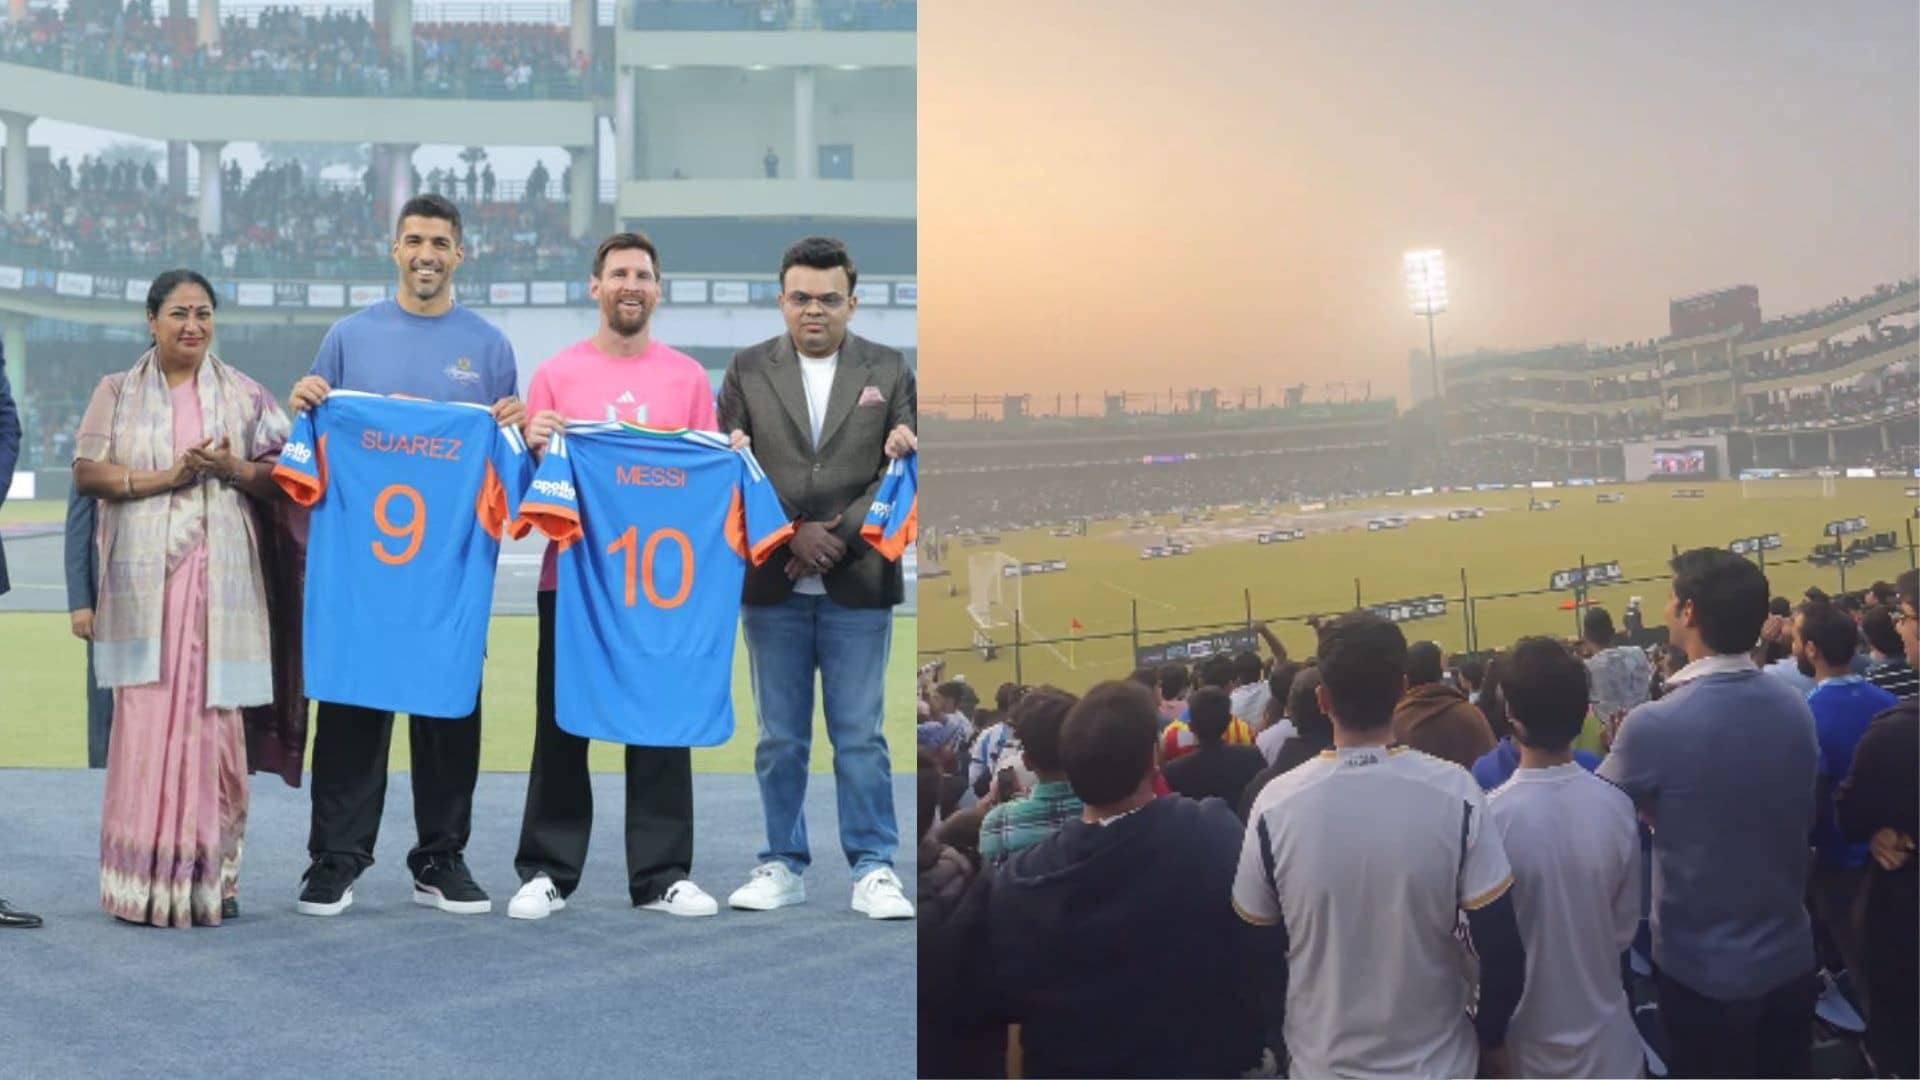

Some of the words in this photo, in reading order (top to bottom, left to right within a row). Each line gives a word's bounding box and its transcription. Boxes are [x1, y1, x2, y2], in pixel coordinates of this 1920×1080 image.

[361, 429, 463, 461] SUAREZ
[616, 464, 687, 488] MESSI
[370, 483, 427, 565] 9
[606, 525, 695, 609] 10
